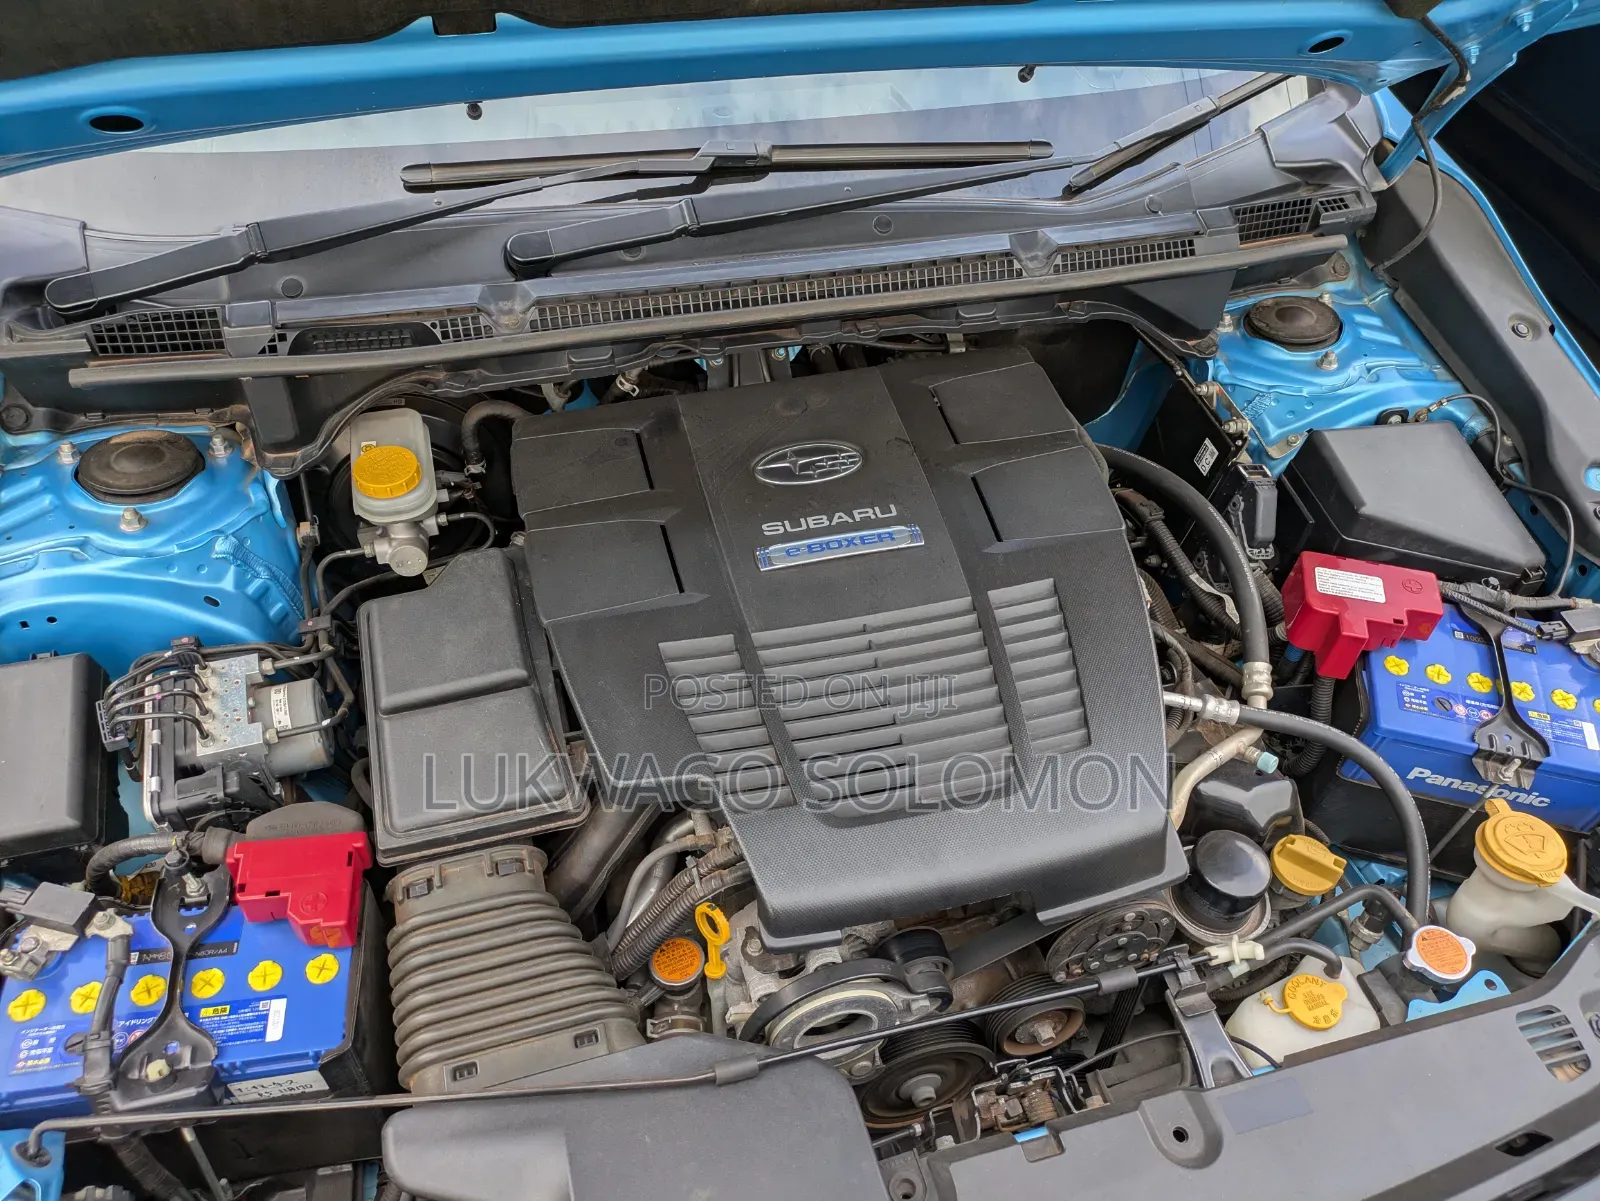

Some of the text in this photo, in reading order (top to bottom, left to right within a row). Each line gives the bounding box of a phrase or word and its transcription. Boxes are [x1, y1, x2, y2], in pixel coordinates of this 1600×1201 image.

[761, 503, 898, 536] SUBARU
[785, 530, 896, 558] e-BOXER
[1406, 766, 1551, 808] Panasonic
[1287, 976, 1327, 1000] COOLANT
